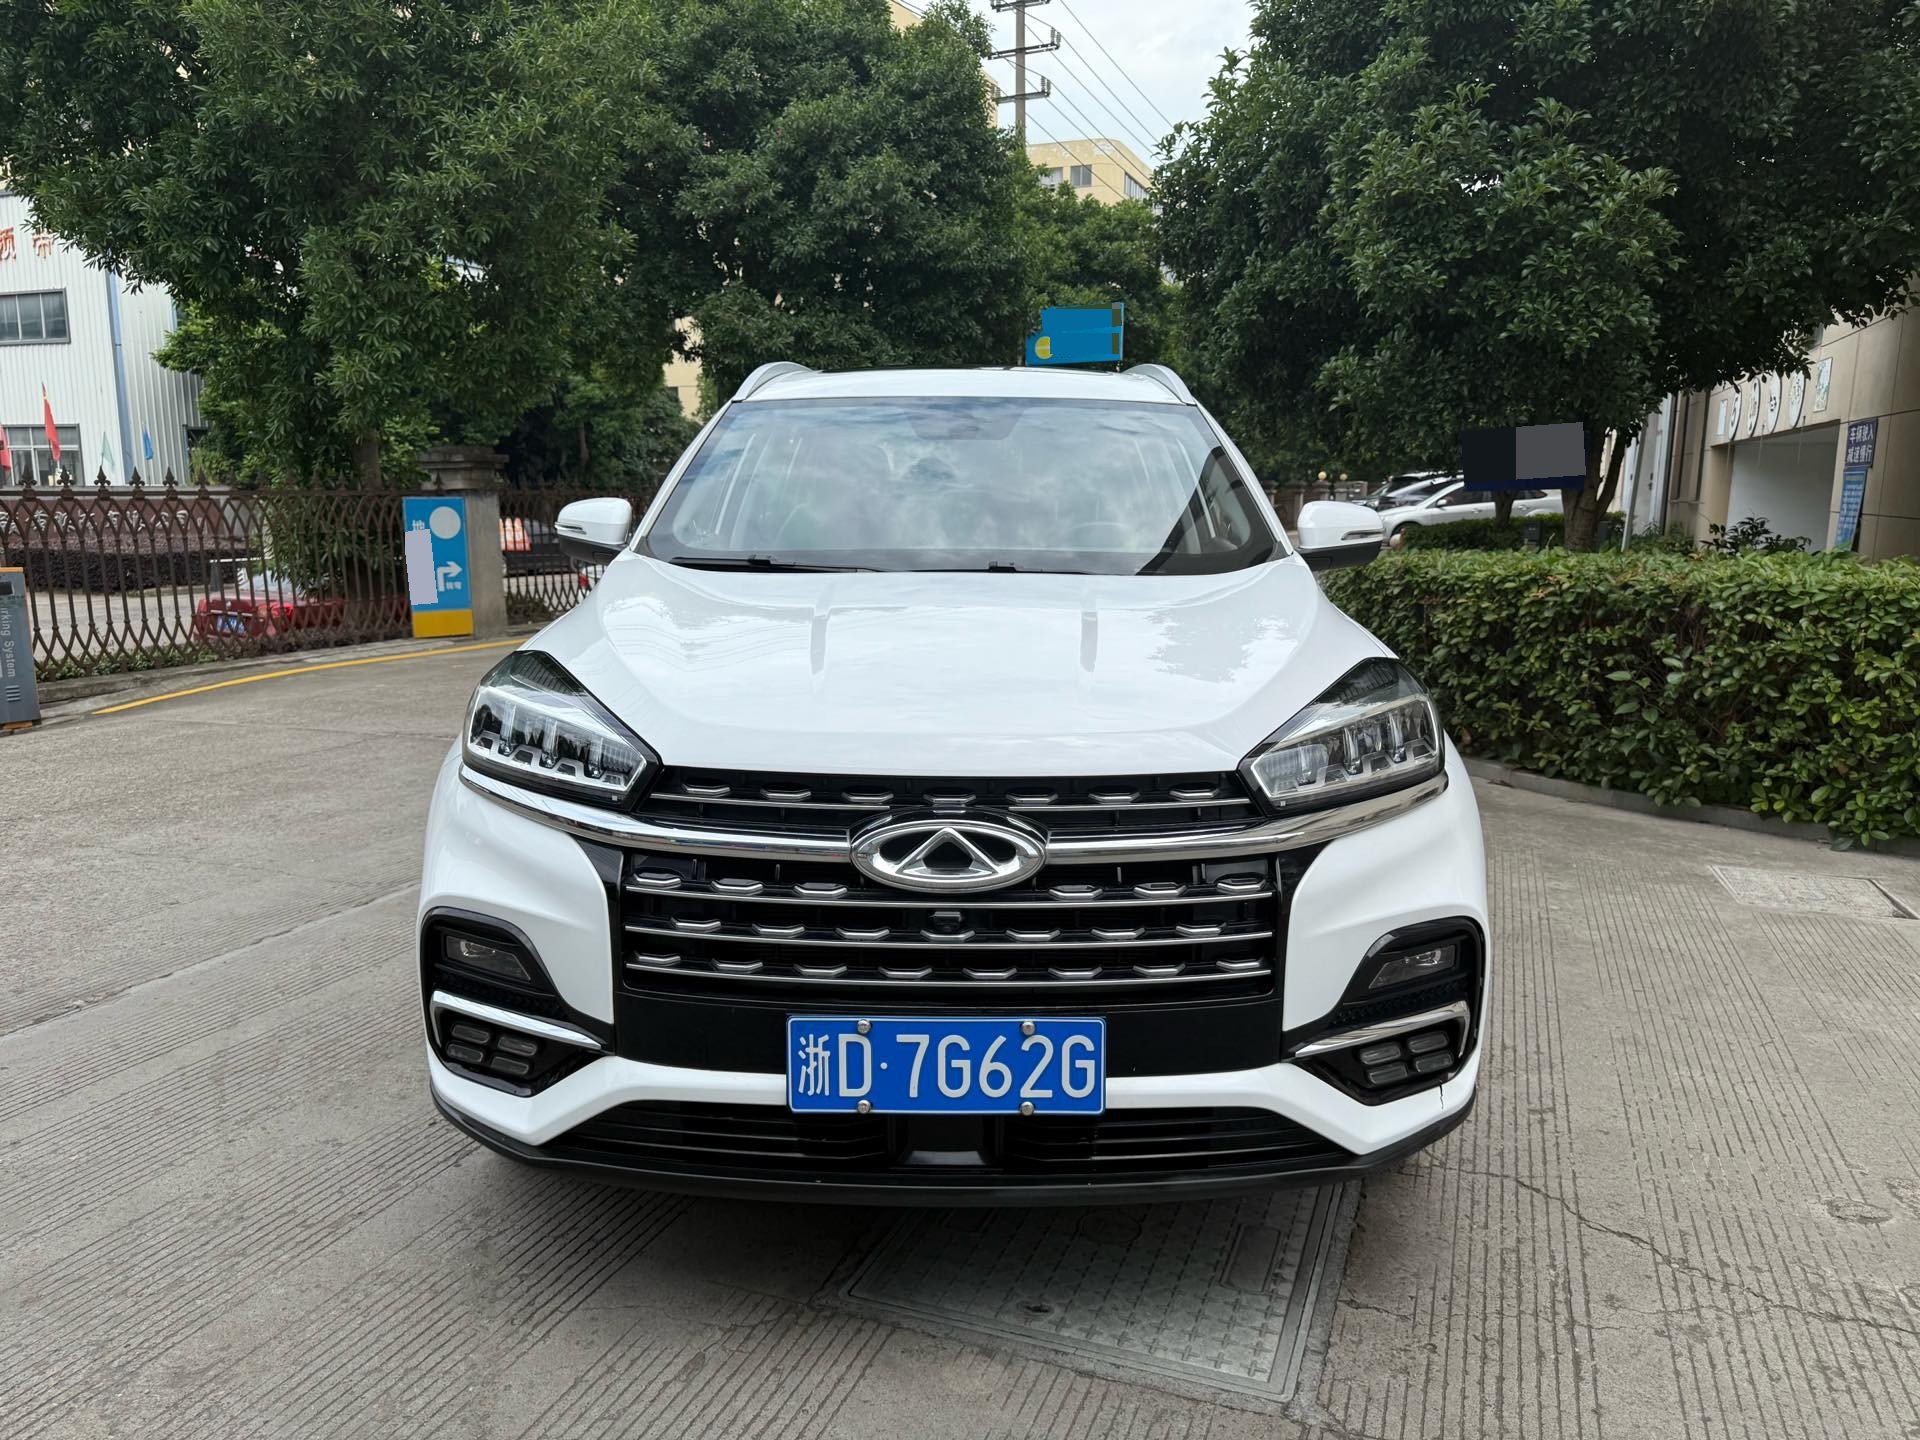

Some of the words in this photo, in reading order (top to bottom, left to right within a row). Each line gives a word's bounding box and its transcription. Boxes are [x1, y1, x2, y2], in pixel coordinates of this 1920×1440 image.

[1847, 445, 1873, 463] 减速慢行
[0, 606, 11, 636] rking
[2, 640, 16, 678] System
[798, 1033, 1096, 1098] 浙D·7G62G
